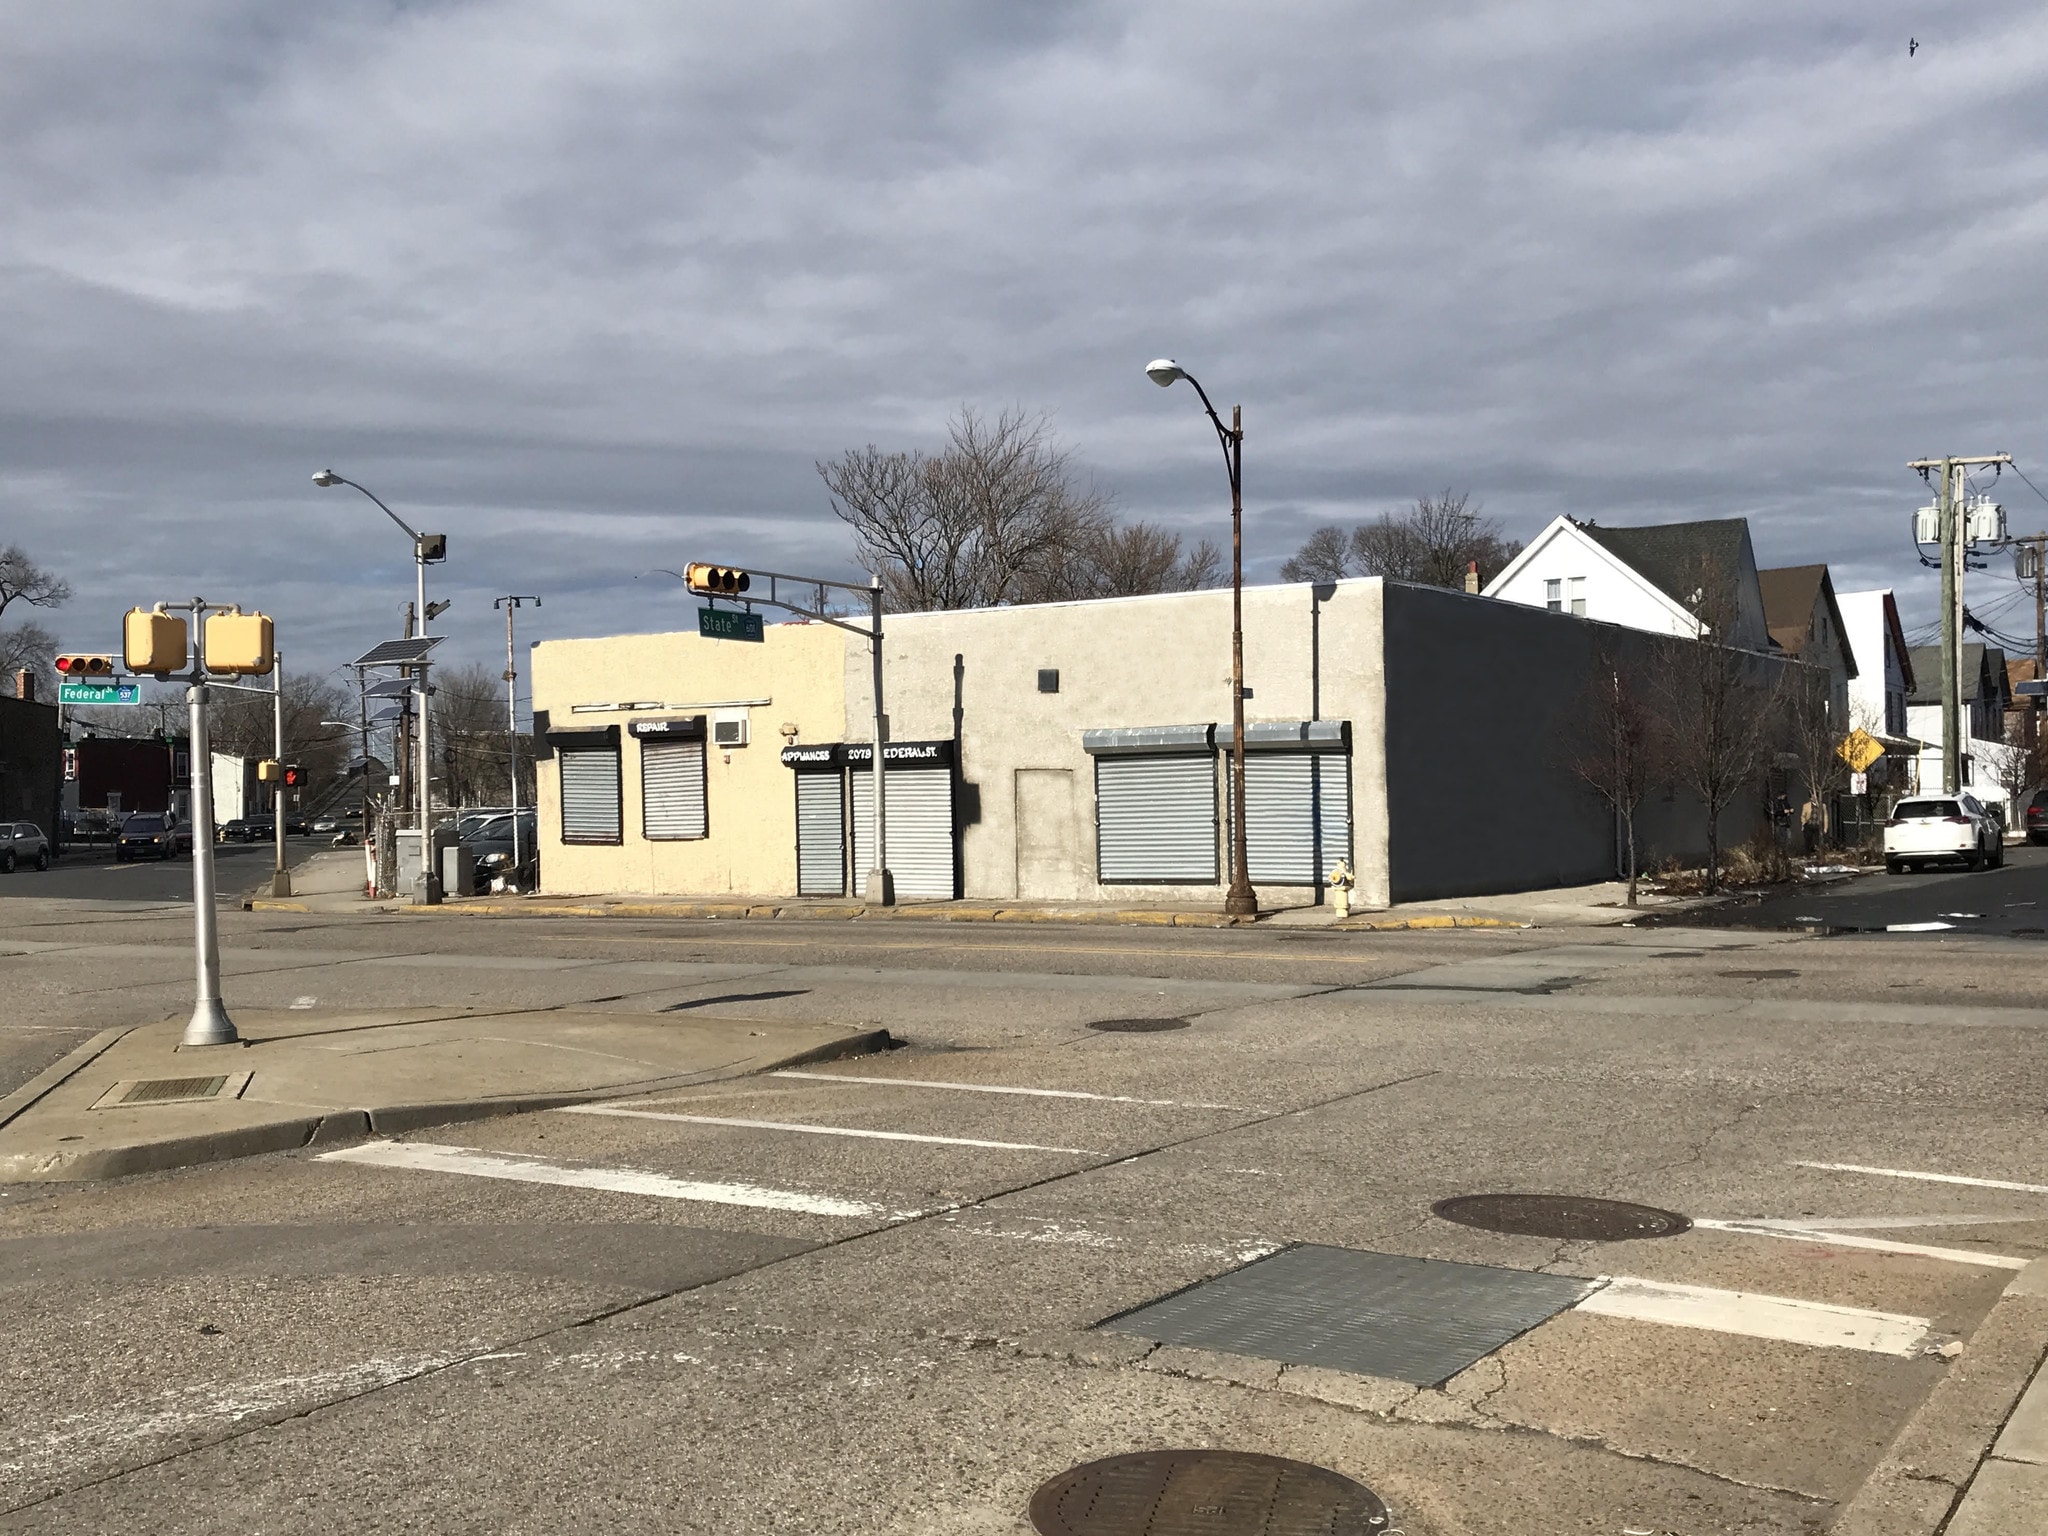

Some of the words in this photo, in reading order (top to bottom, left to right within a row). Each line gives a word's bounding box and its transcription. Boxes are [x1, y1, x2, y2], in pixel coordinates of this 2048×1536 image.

[703, 615, 732, 633] State
[64, 688, 105, 700] Federal
[120, 691, 131, 699] 537
[848, 748, 872, 760] 2079
[881, 746, 925, 759] EDERAL
